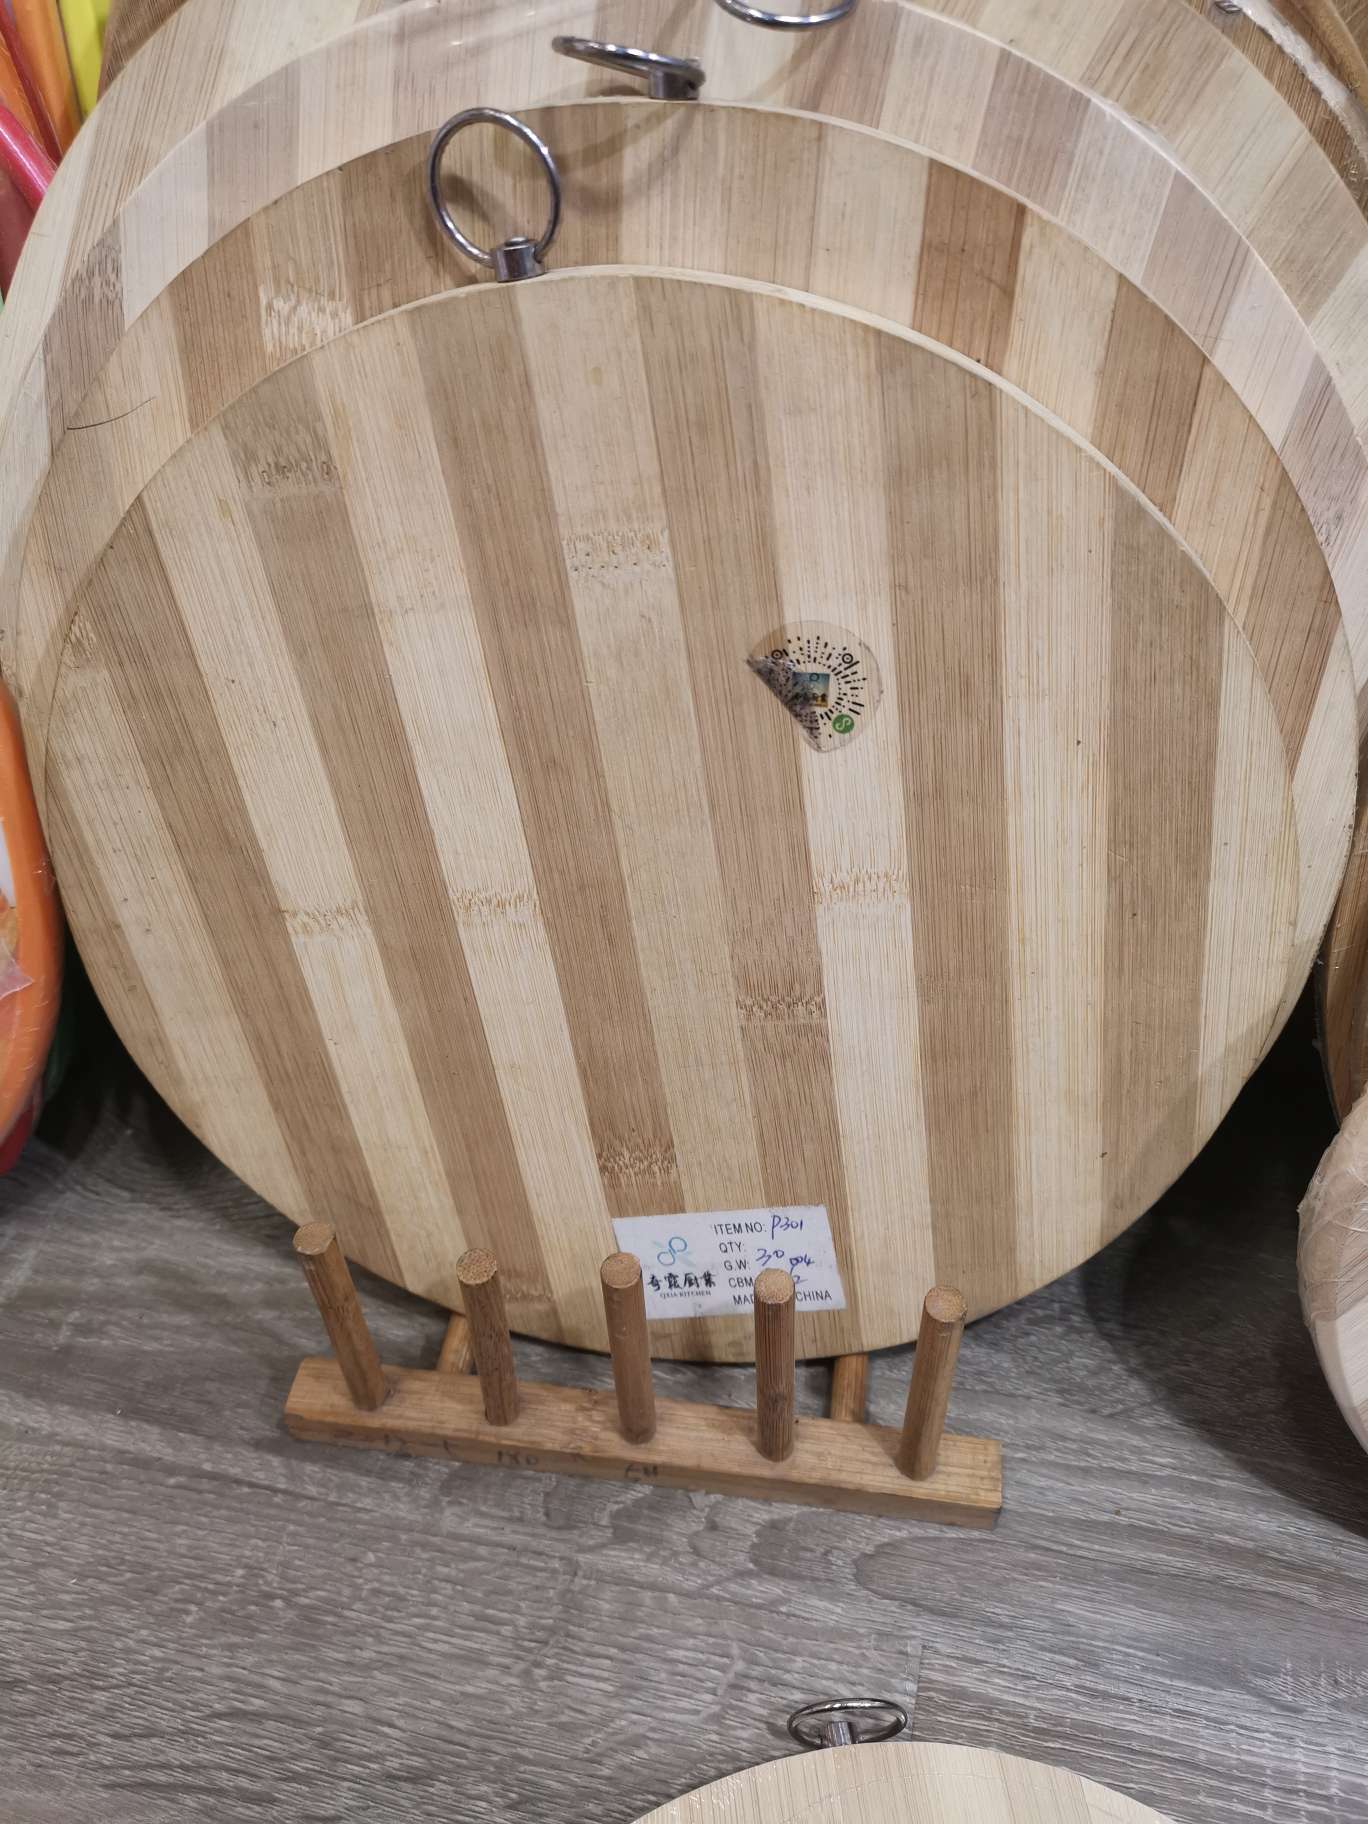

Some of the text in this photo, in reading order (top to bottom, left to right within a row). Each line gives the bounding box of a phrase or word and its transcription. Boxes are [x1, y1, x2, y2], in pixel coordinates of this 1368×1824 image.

[713, 1221, 767, 1236] ITEM NO:
[718, 1241, 746, 1254] QTY:
[795, 1289, 833, 1302] CHINA
